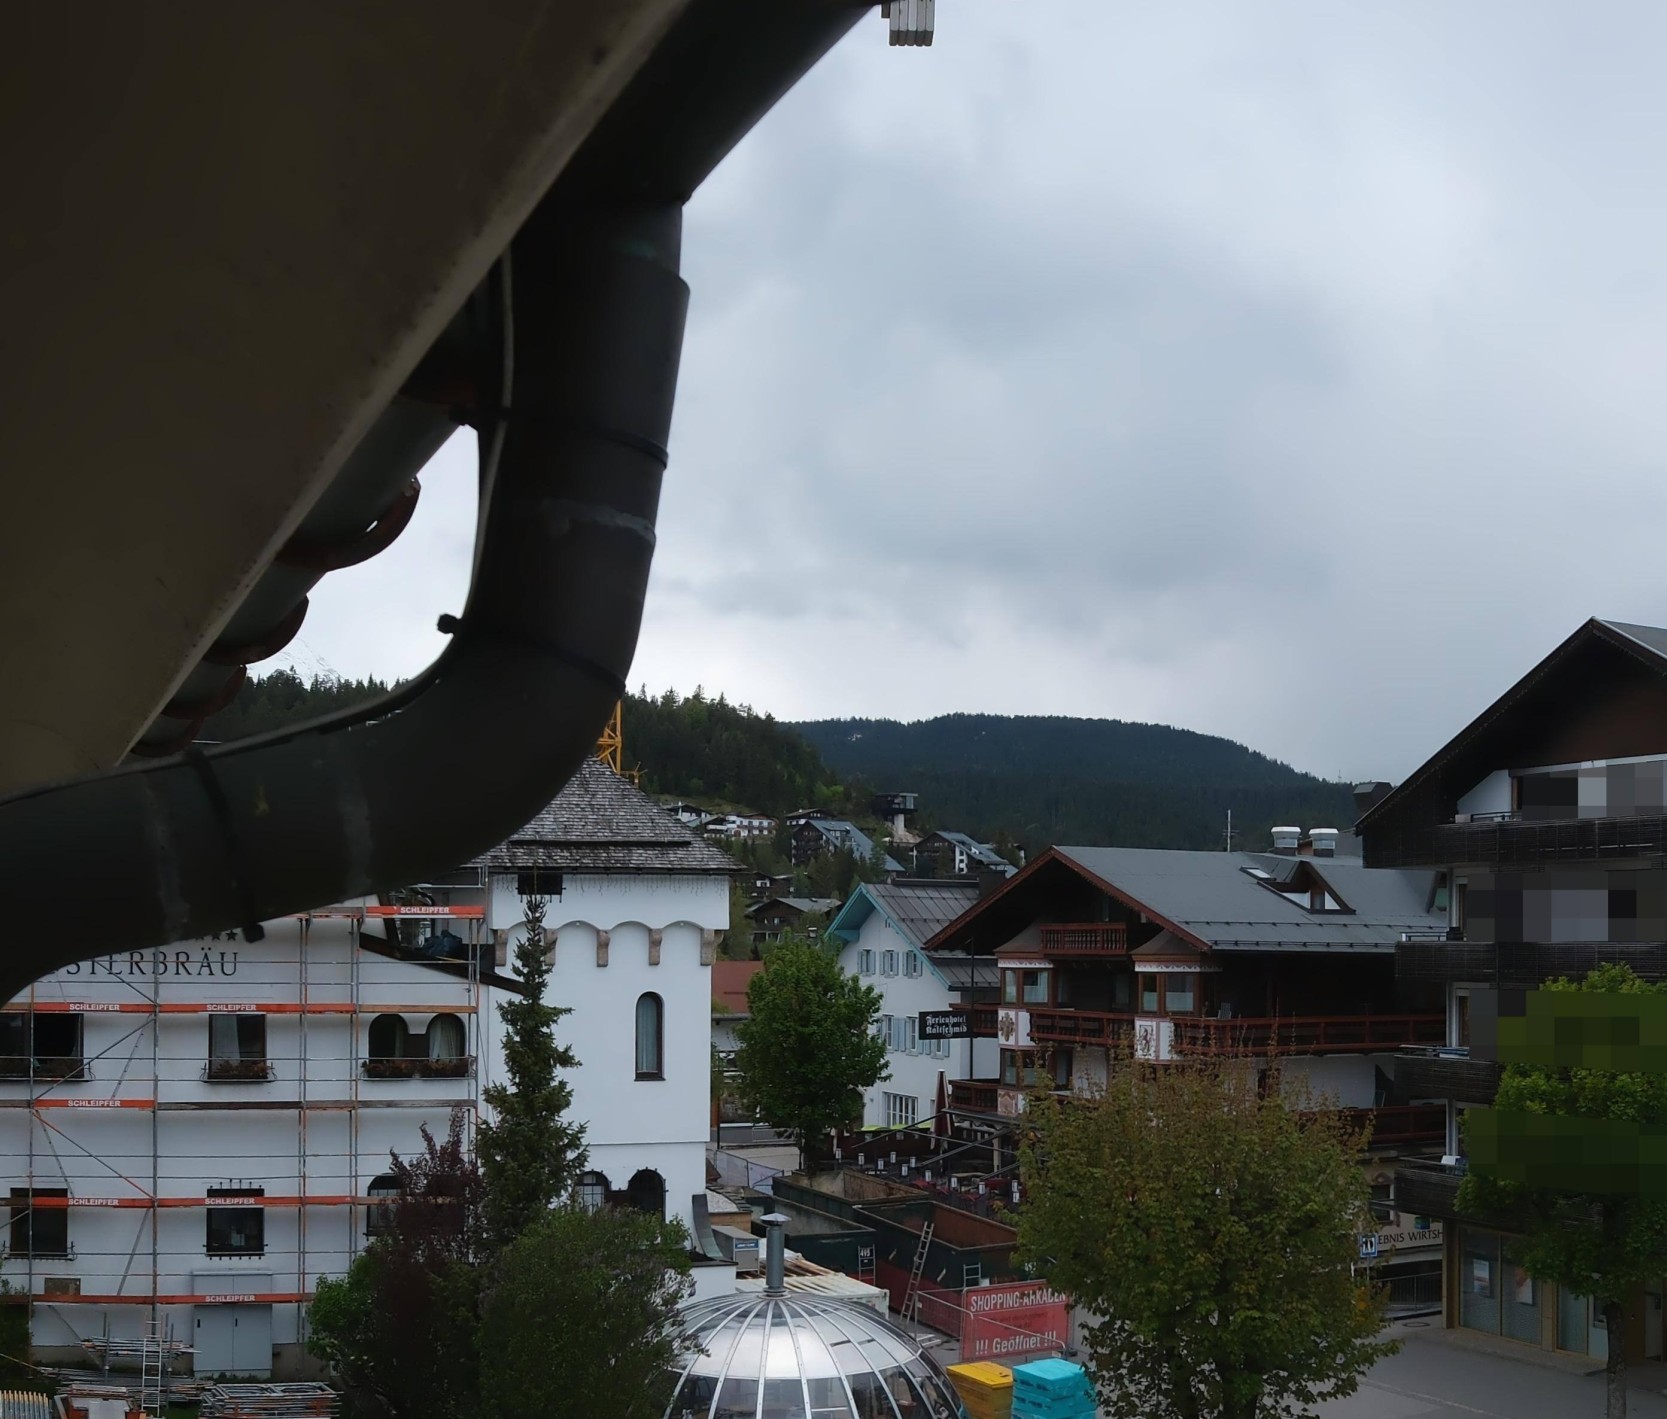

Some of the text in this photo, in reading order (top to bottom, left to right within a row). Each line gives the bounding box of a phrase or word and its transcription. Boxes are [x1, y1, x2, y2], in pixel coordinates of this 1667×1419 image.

[49, 947, 239, 977] STERBRÄU
[69, 1003, 120, 1011] SCHLEIPFER
[206, 1003, 257, 1011] SCHLEIPFER
[67, 1099, 121, 1107] SCHLEIPFER
[68, 1198, 119, 1206] SCHLEIPFER
[204, 1197, 255, 1205] SCHLEIPFER
[1378, 1232, 1405, 1245] EBNIS
[205, 1294, 256, 1302] SCHLEIPFER
